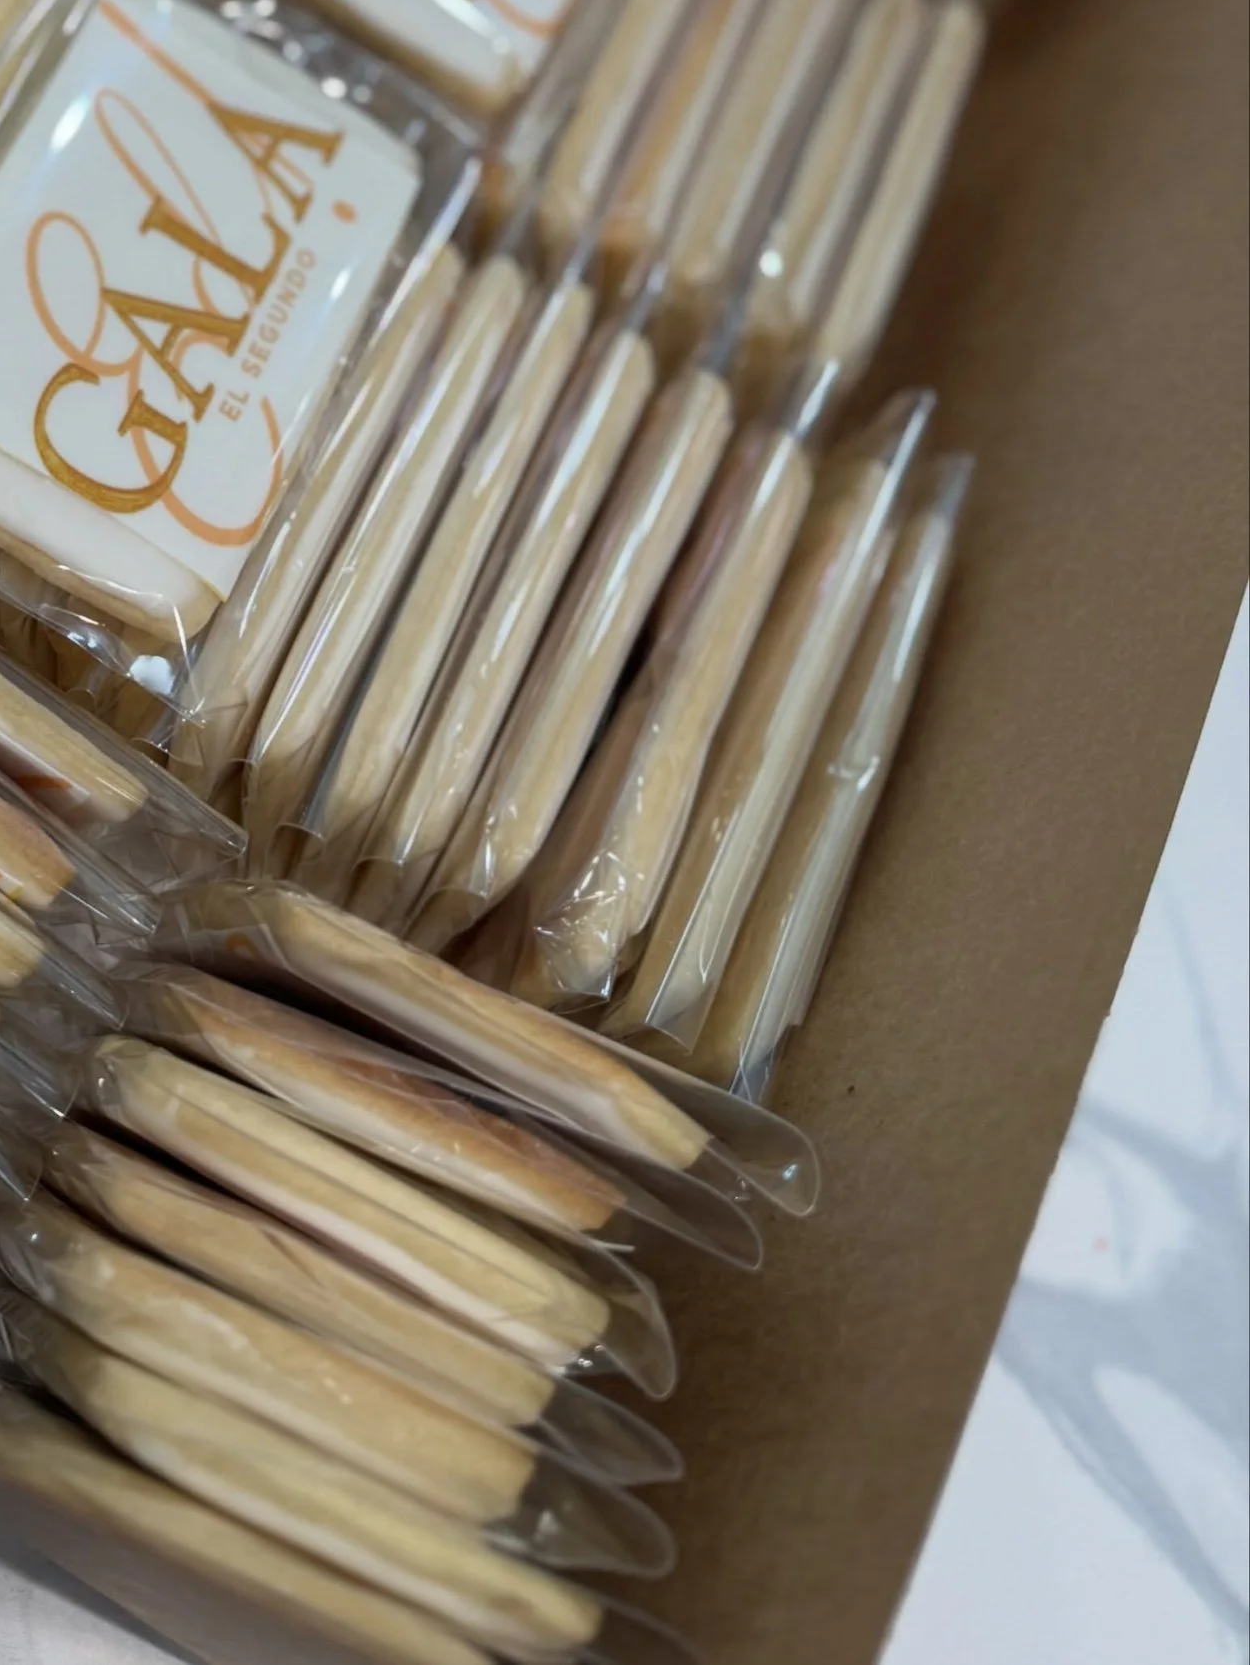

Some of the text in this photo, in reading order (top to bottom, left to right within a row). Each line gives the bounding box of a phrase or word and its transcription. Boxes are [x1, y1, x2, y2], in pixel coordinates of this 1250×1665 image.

[33, 101, 345, 514] GALA
[218, 247, 317, 422] EL SEGUNDO
